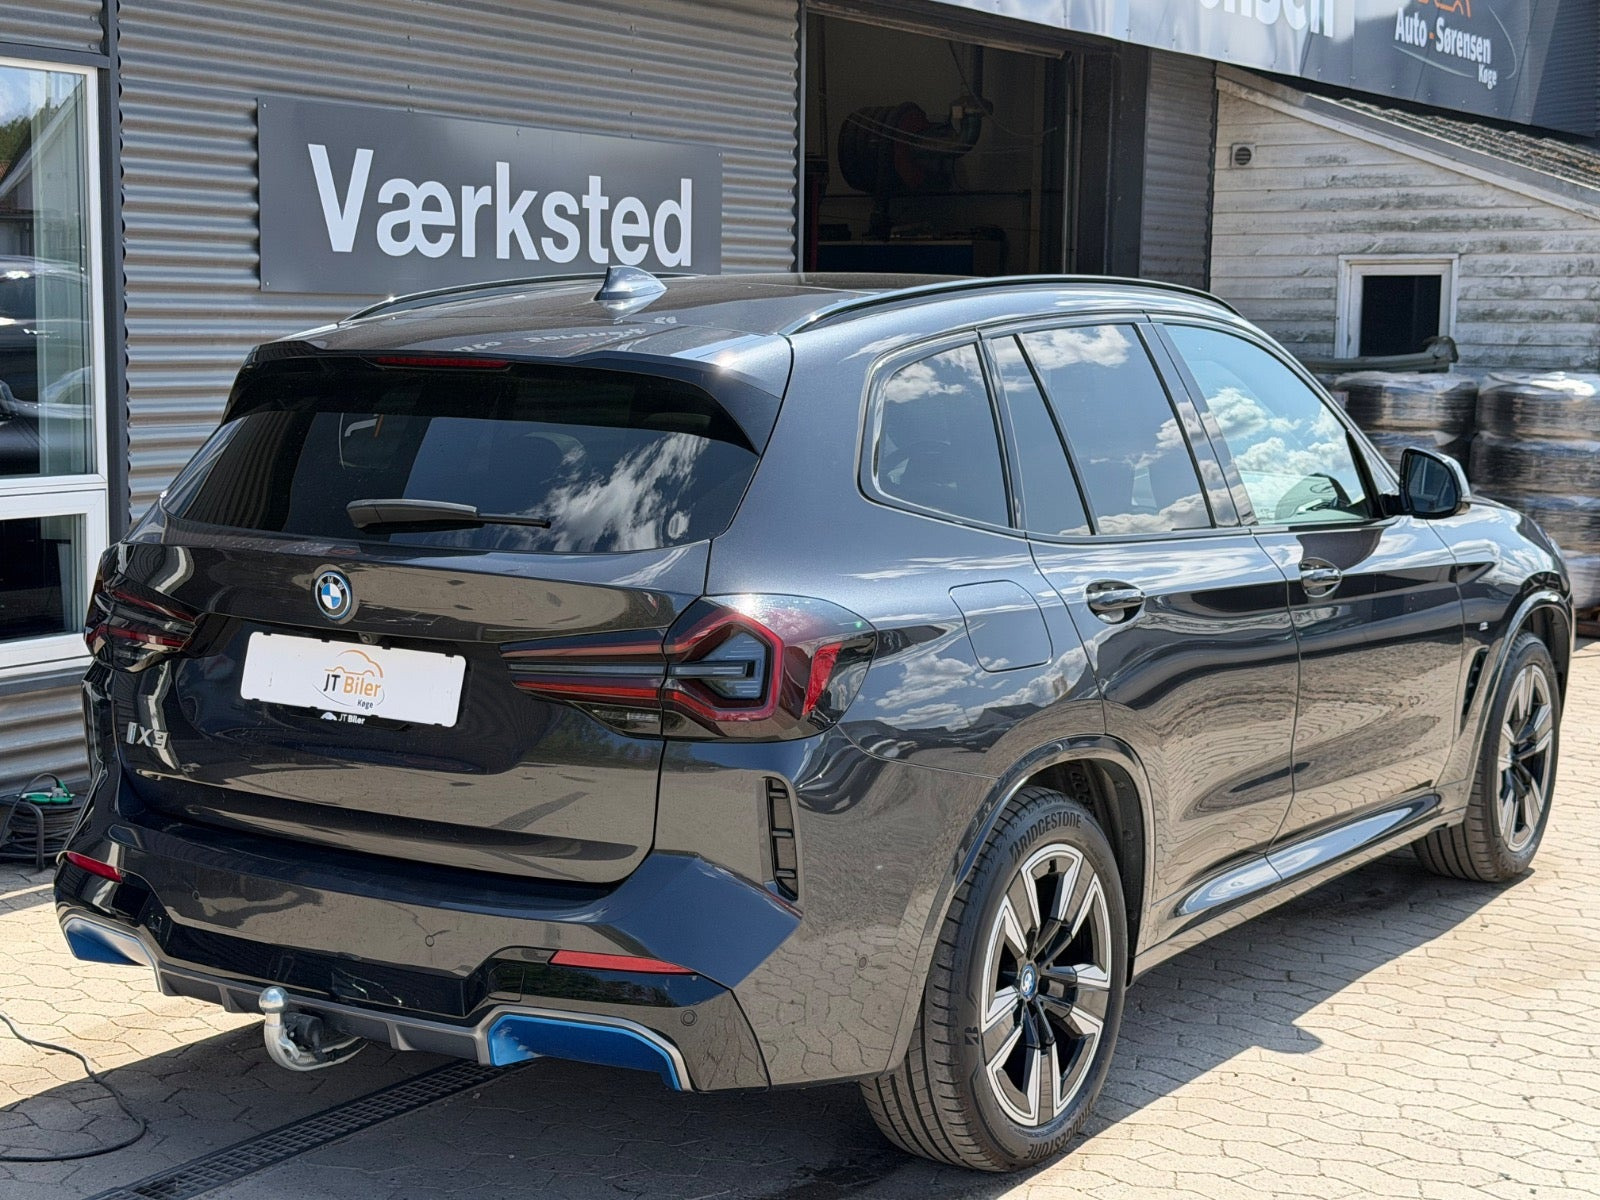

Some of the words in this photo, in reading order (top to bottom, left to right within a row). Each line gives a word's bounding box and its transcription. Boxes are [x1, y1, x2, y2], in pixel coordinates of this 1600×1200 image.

[308, 144, 692, 267] Værksted
[323, 674, 341, 692] JT
[343, 676, 381, 697] Biler
[347, 715, 366, 725] Biler
[1010, 811, 1082, 864] BRIDGESTONE
